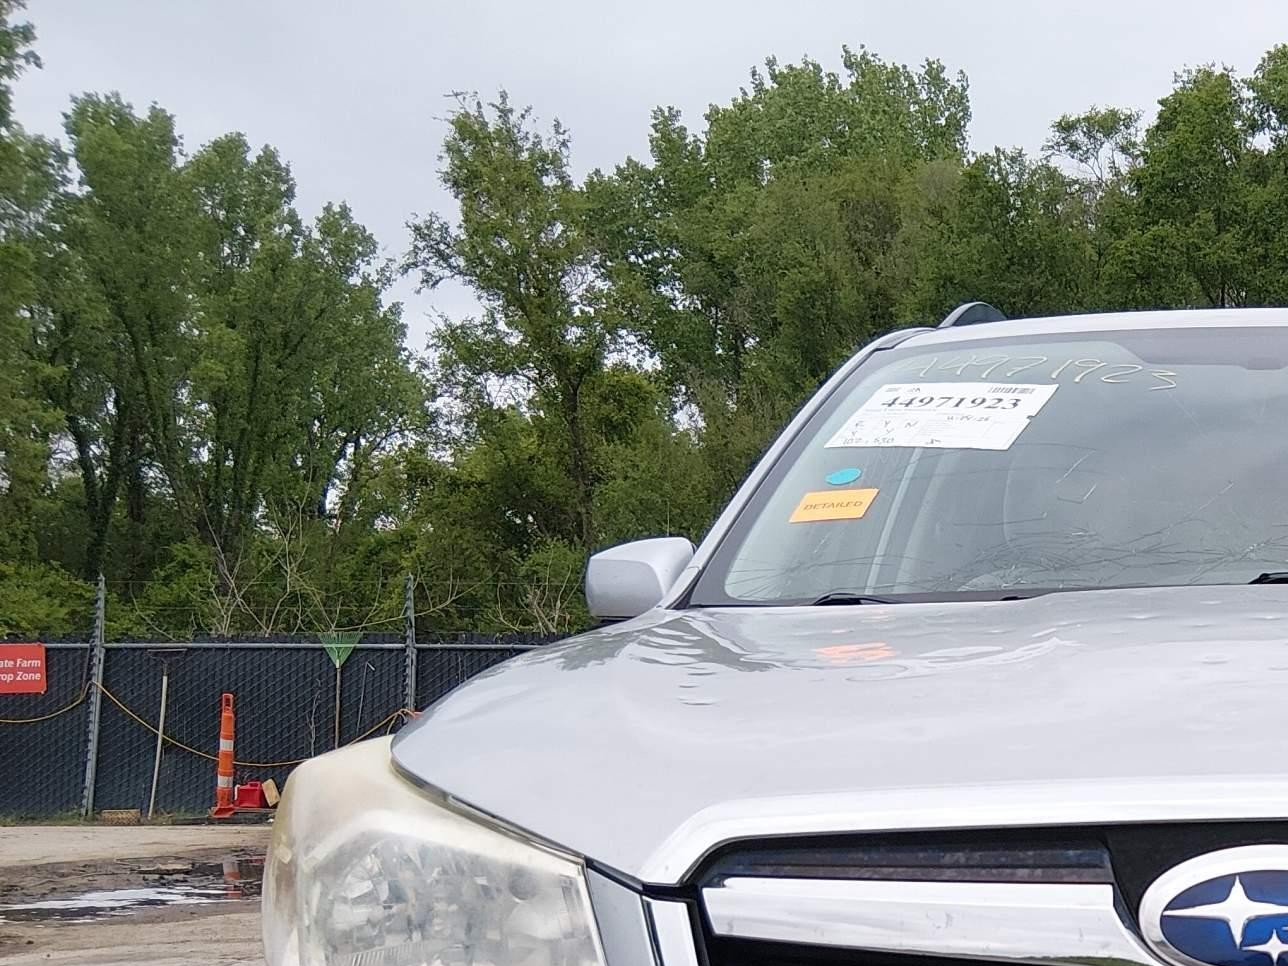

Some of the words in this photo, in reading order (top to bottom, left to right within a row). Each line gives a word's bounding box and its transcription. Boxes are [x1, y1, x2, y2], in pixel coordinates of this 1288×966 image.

[881, 396, 1022, 410] 44971923
[803, 500, 864, 511] DETAILED
[16, 658, 41, 668] Farm
[16, 672, 41, 681] Zone
